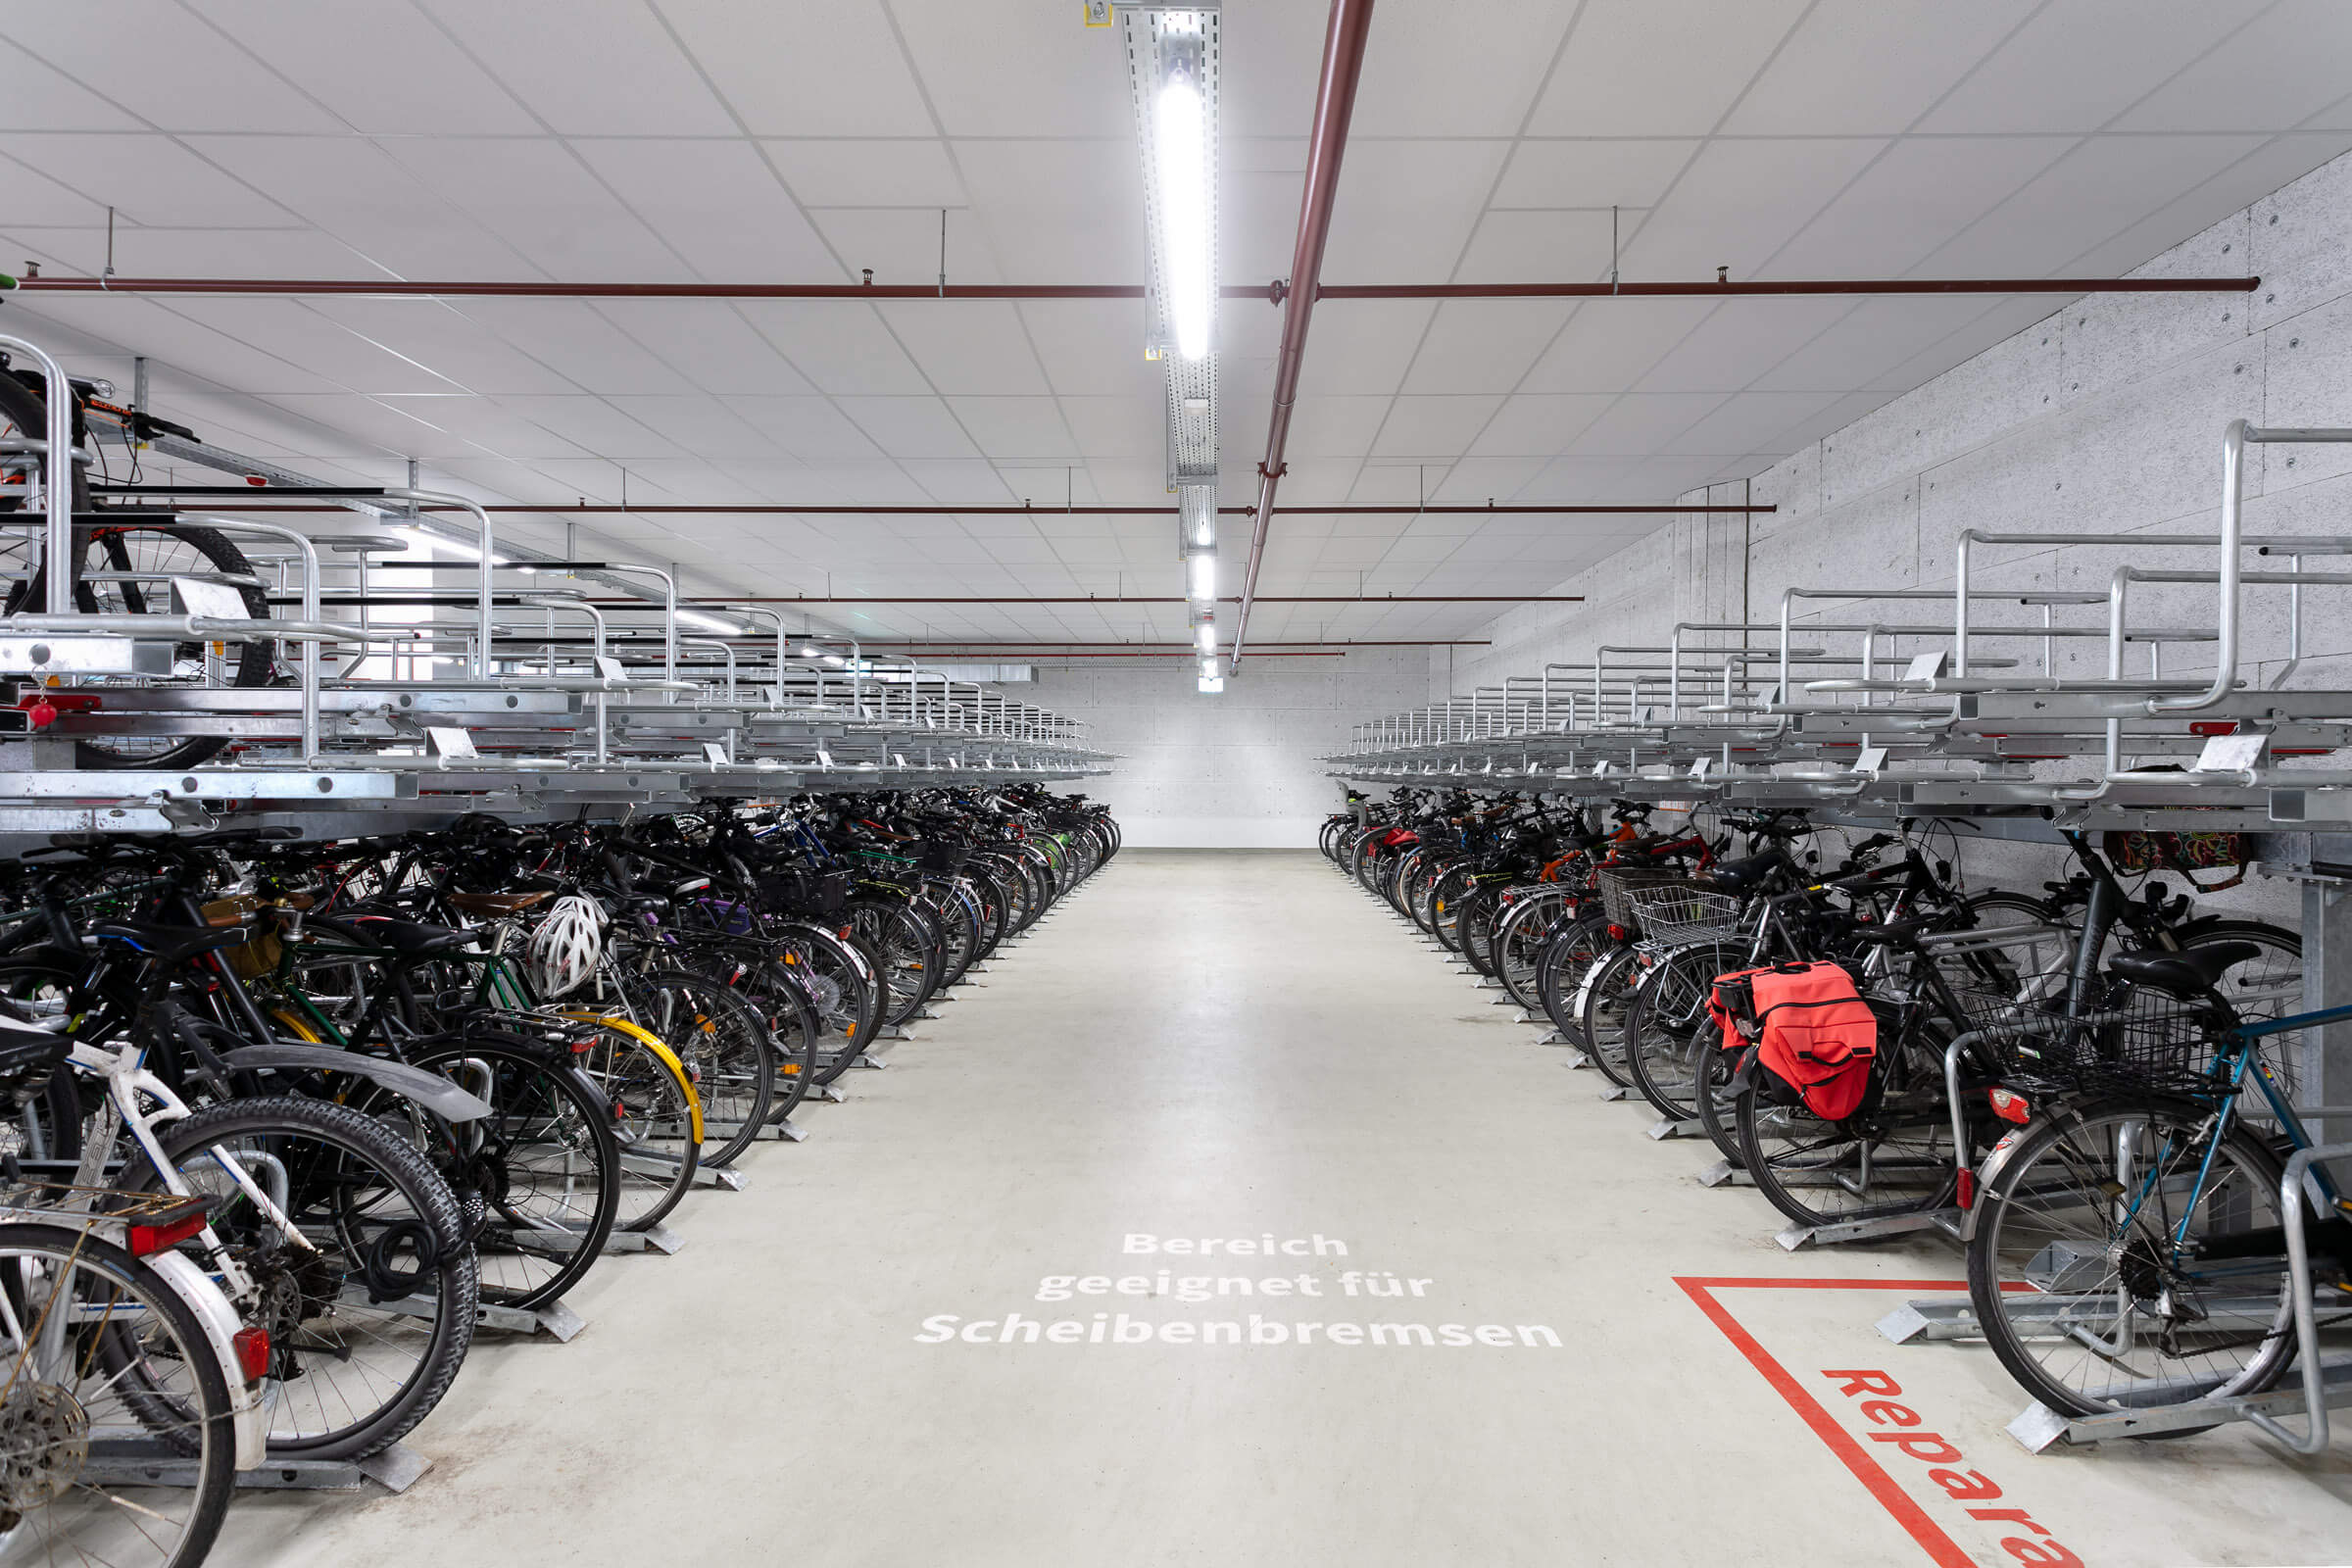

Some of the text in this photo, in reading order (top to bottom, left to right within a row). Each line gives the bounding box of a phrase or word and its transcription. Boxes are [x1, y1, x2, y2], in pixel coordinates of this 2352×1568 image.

[1122, 1233, 1349, 1256] Bereich
[1034, 1269, 1434, 1302] geeignet für
[912, 1312, 1564, 1348] Scheibenbremsen
[1820, 1369, 2085, 1568] Repara
